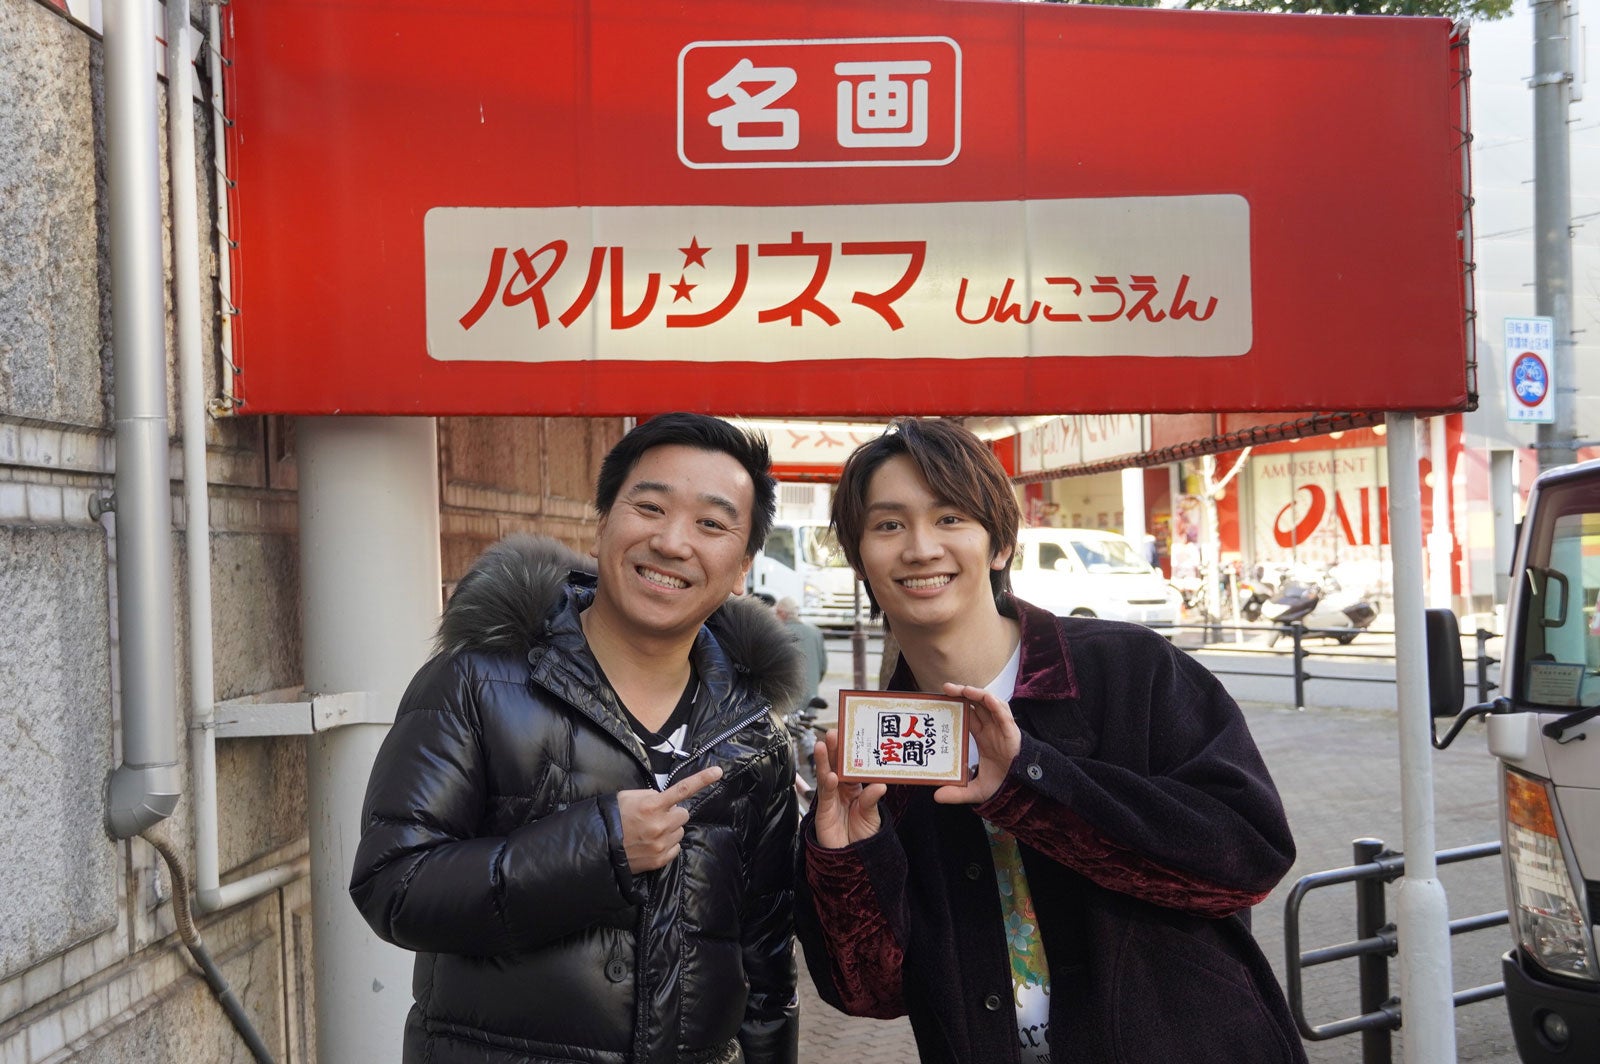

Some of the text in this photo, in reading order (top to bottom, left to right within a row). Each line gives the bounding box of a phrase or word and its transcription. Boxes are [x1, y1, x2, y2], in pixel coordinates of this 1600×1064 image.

[707, 58, 932, 151] 名画
[458, 231, 1219, 332] パルシネマ しんこうえん
[1261, 457, 1368, 478] AMUSEMENT
[923, 717, 937, 756] となりの
